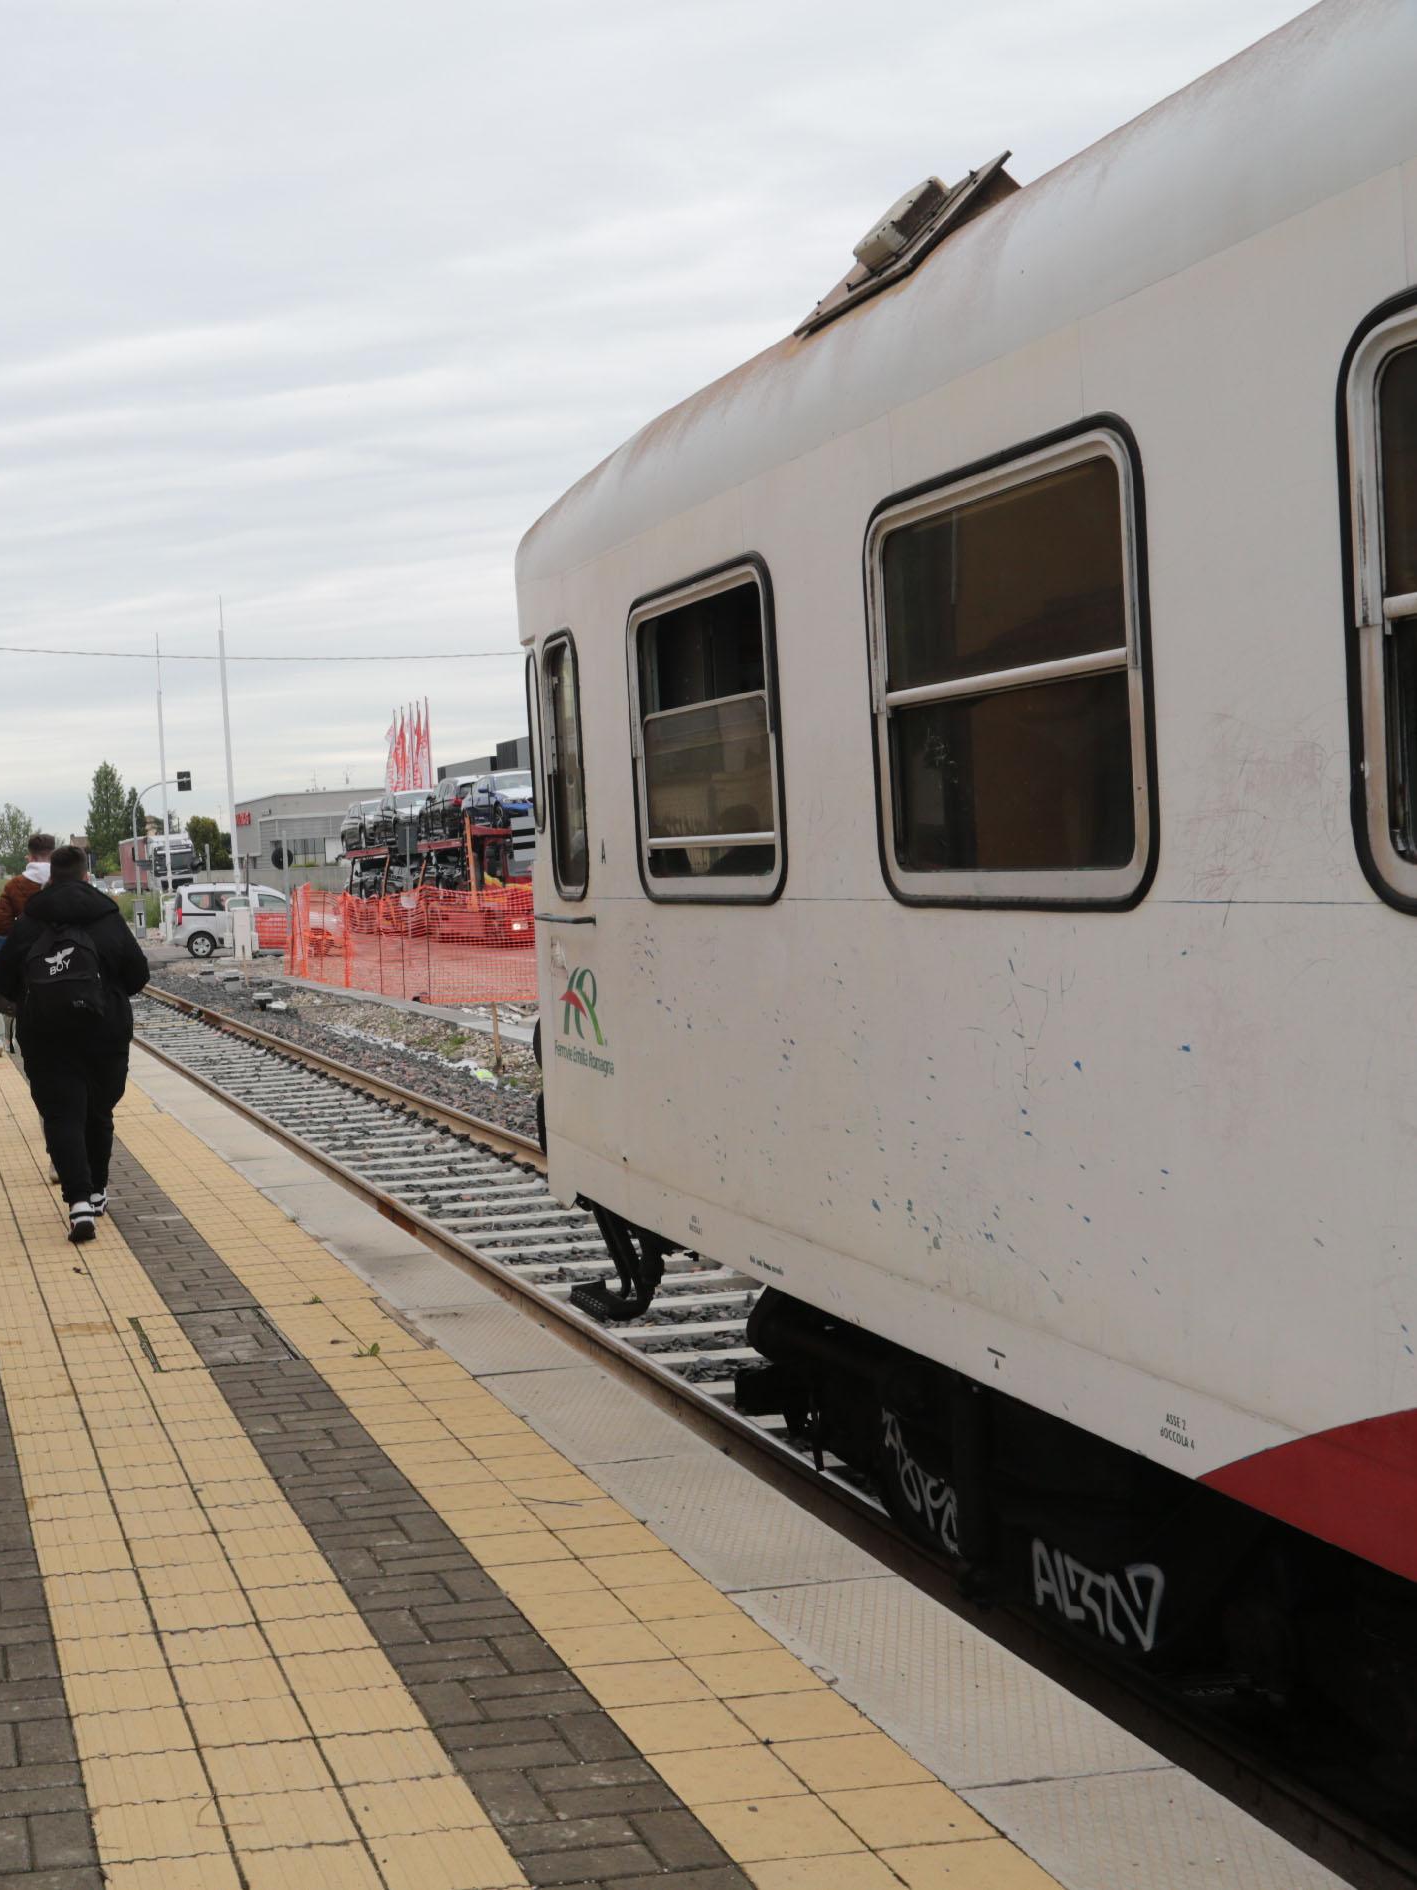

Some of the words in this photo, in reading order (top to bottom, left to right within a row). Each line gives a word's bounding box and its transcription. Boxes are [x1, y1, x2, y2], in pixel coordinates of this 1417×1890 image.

[137, 912, 143, 926] T
[49, 959, 70, 975] BOY
[589, 1051, 615, 1078] Romagna
[1166, 1413, 1181, 1429] ASSE
[1182, 1419, 1187, 1431] 2
